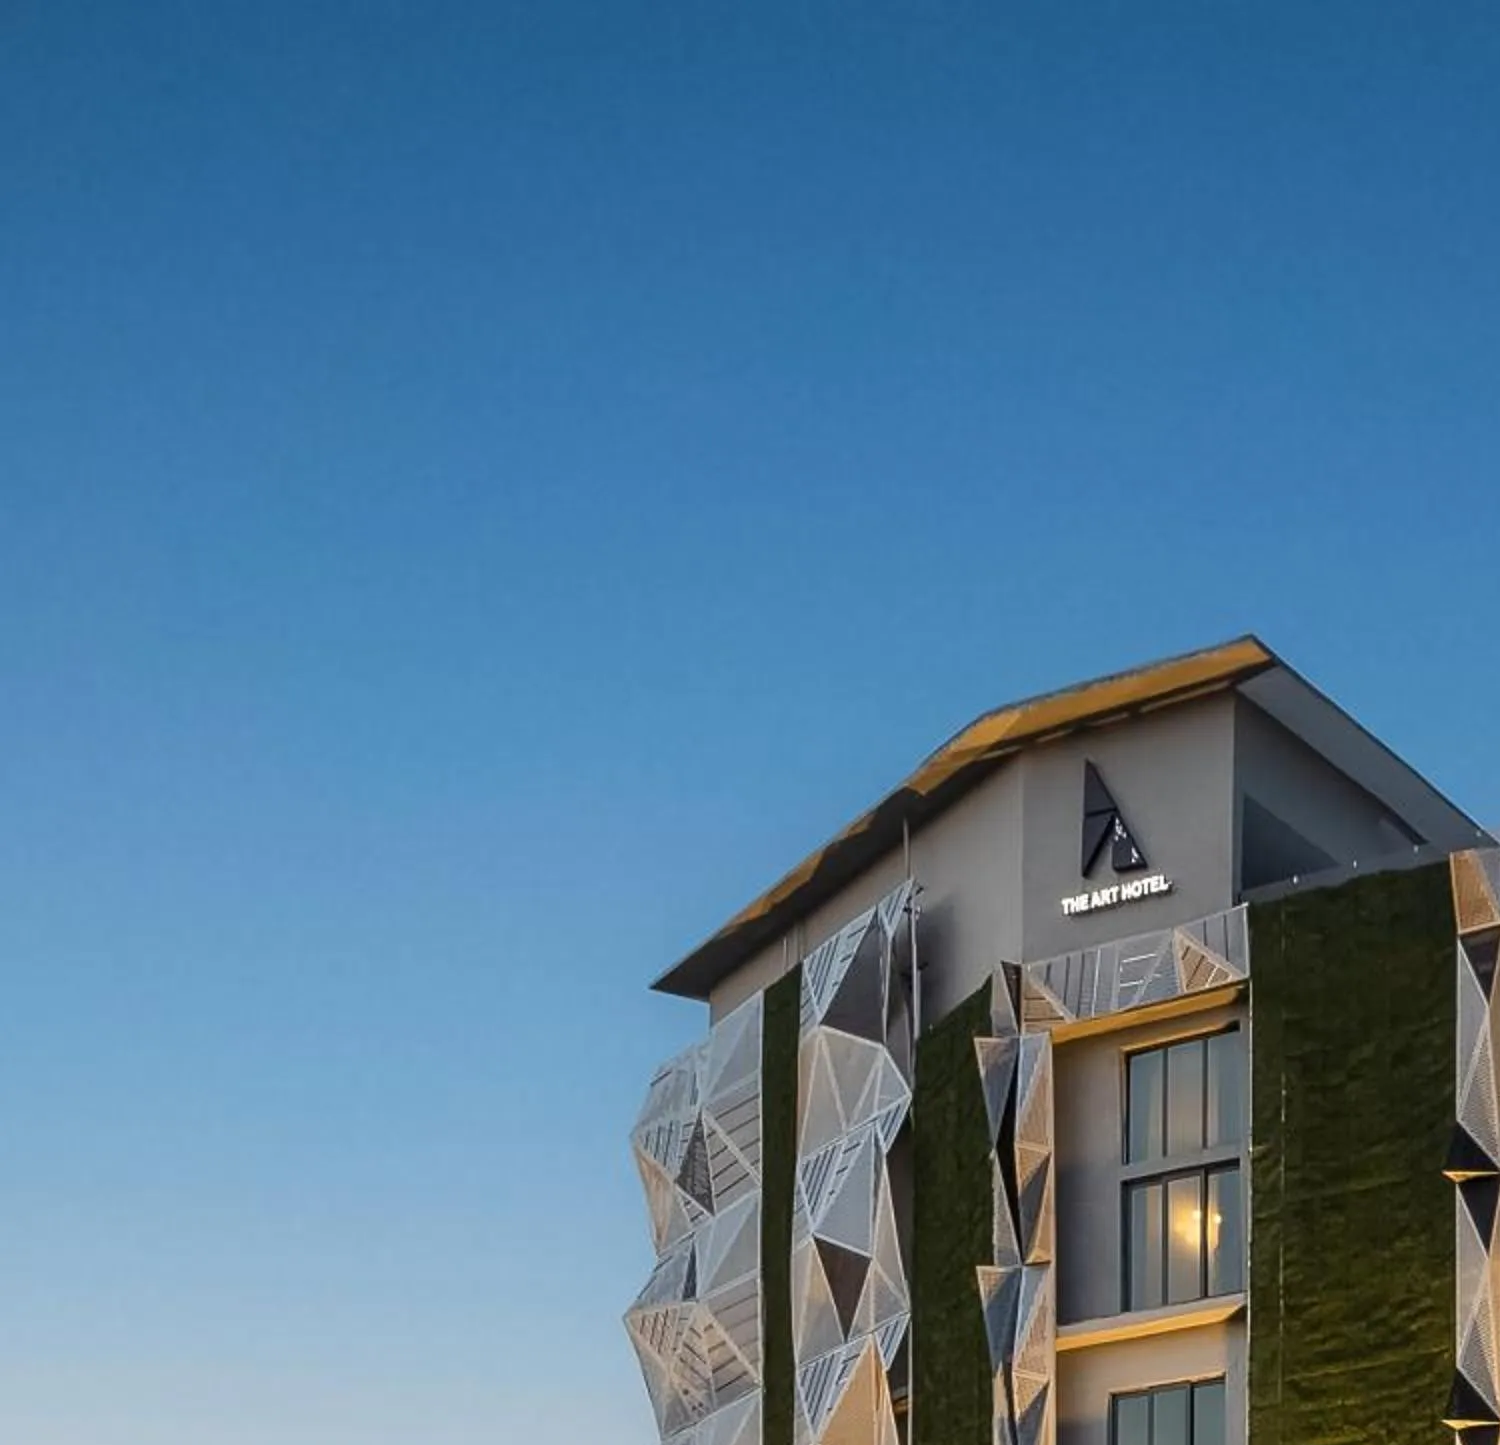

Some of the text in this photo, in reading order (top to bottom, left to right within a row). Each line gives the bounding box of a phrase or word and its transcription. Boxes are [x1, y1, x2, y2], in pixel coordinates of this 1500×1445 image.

[1061, 874, 1169, 915] THE ART HOTEL
